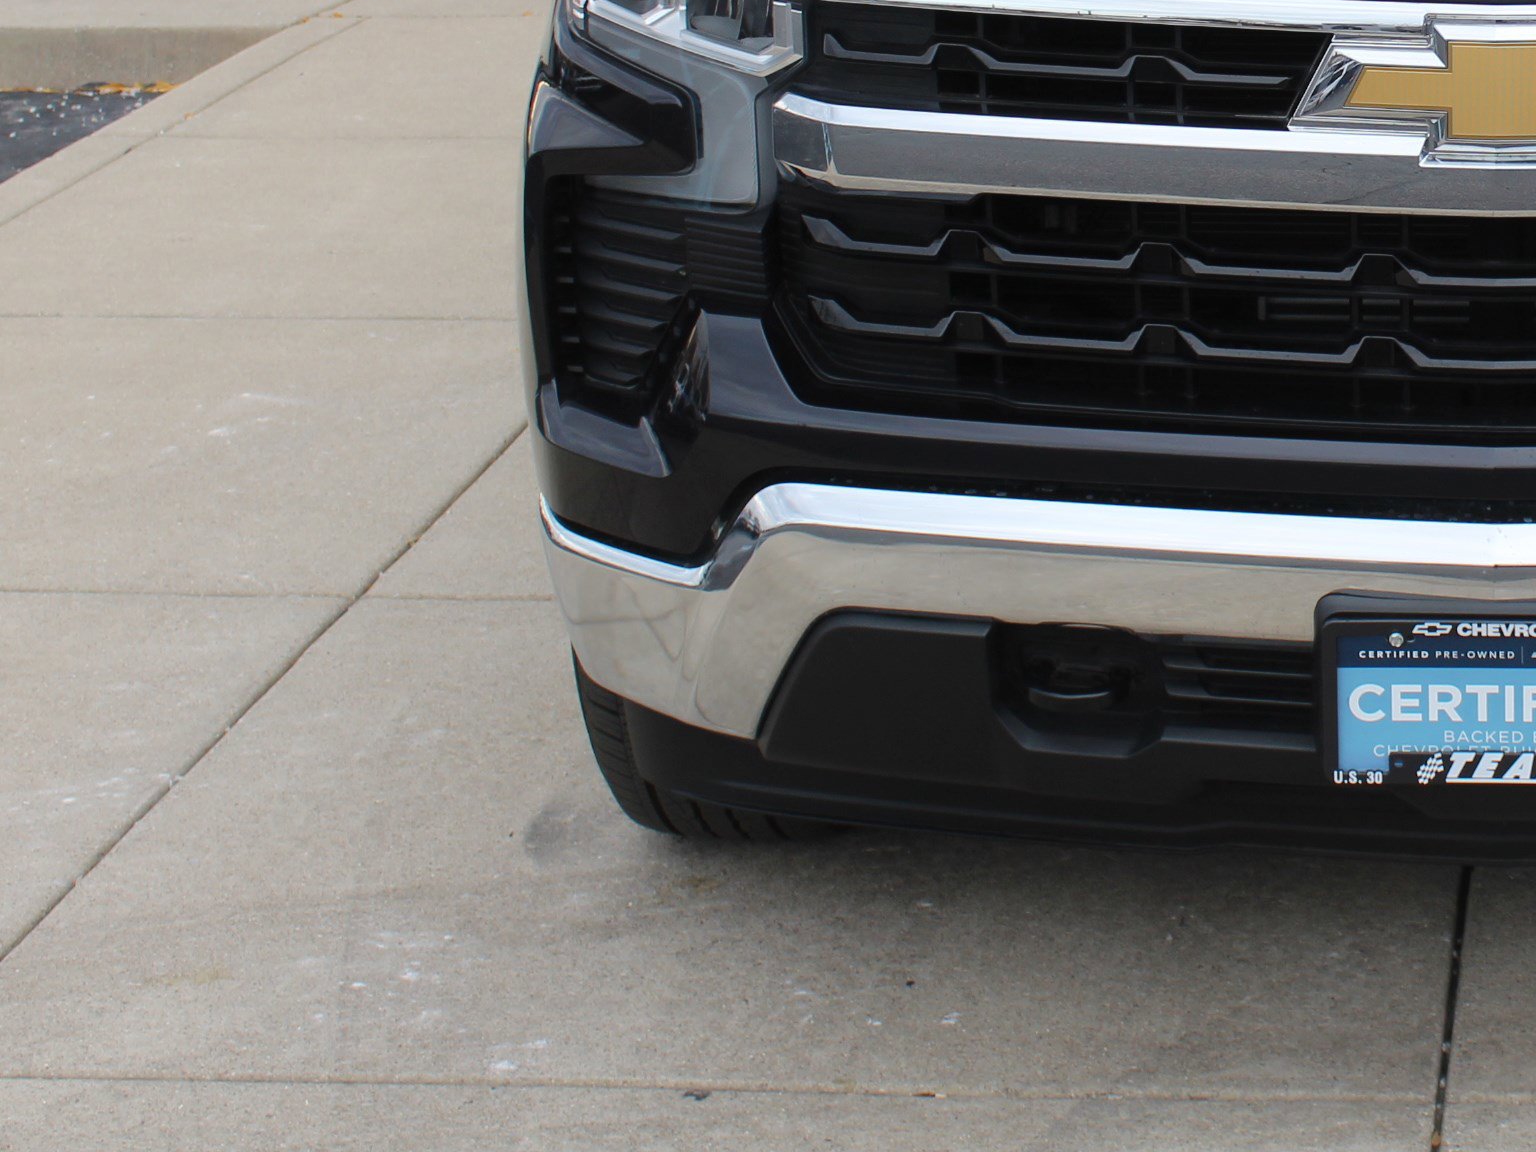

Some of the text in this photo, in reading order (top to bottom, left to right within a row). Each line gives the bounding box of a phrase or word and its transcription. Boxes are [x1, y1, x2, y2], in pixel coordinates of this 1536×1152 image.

[1358, 650, 1516, 660] CERTIFIED PRE-OWNED
[1444, 730, 1524, 744] BACKED
[1333, 770, 1383, 784] U.S. 30
